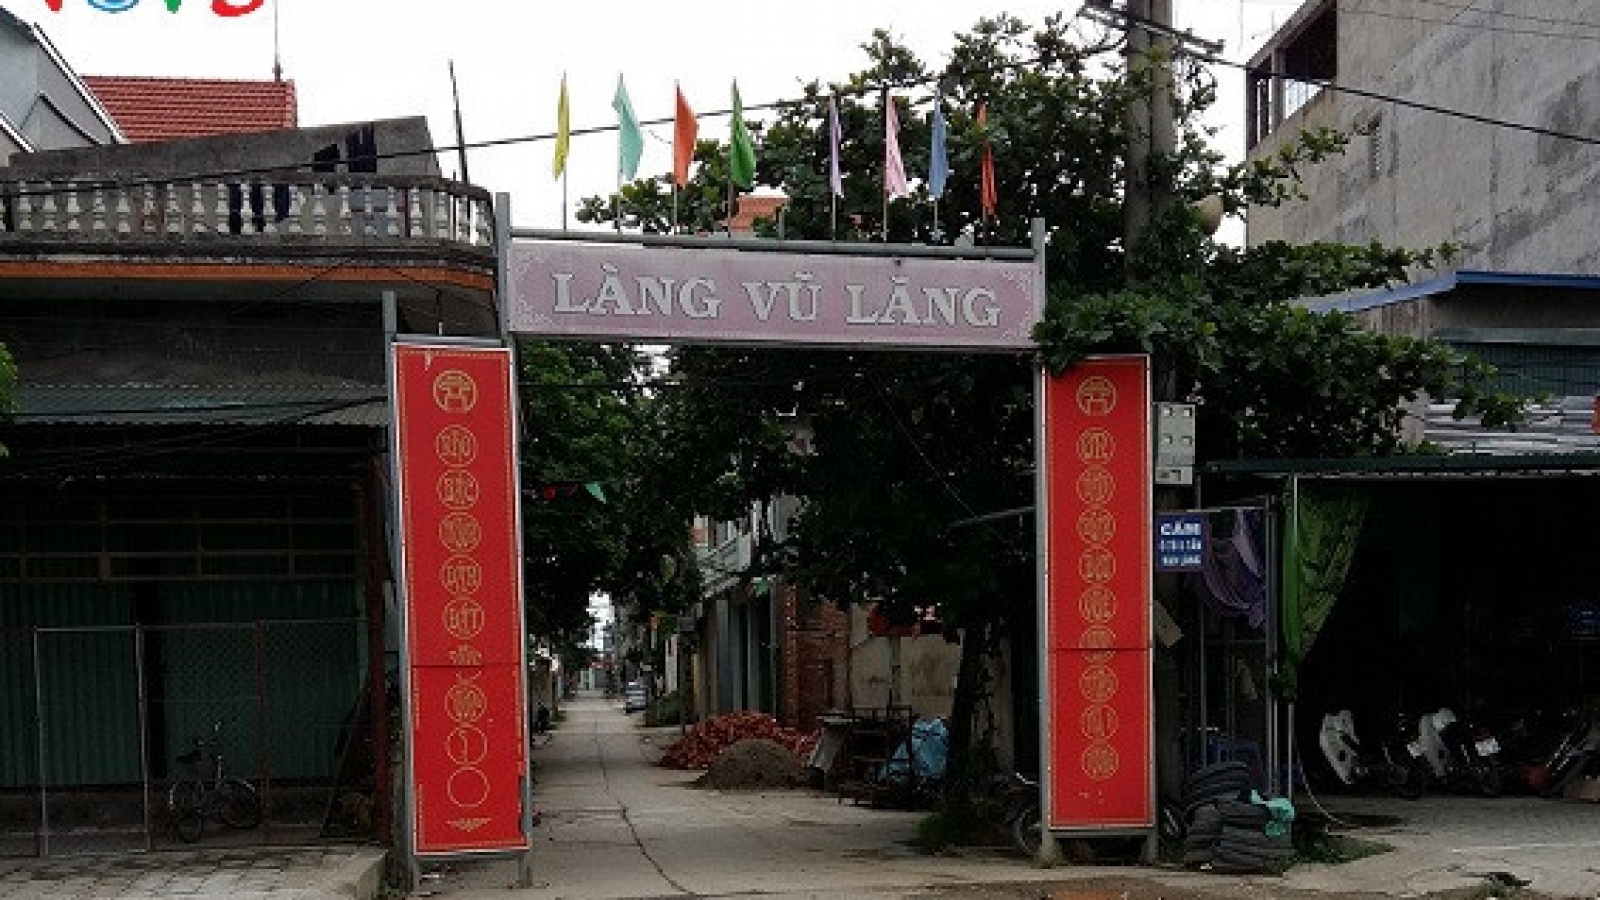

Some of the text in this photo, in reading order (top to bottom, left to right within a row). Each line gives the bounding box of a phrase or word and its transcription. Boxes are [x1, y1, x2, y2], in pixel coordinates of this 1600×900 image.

[551, 262, 1001, 327] LÀNG VŨ LĂNG
